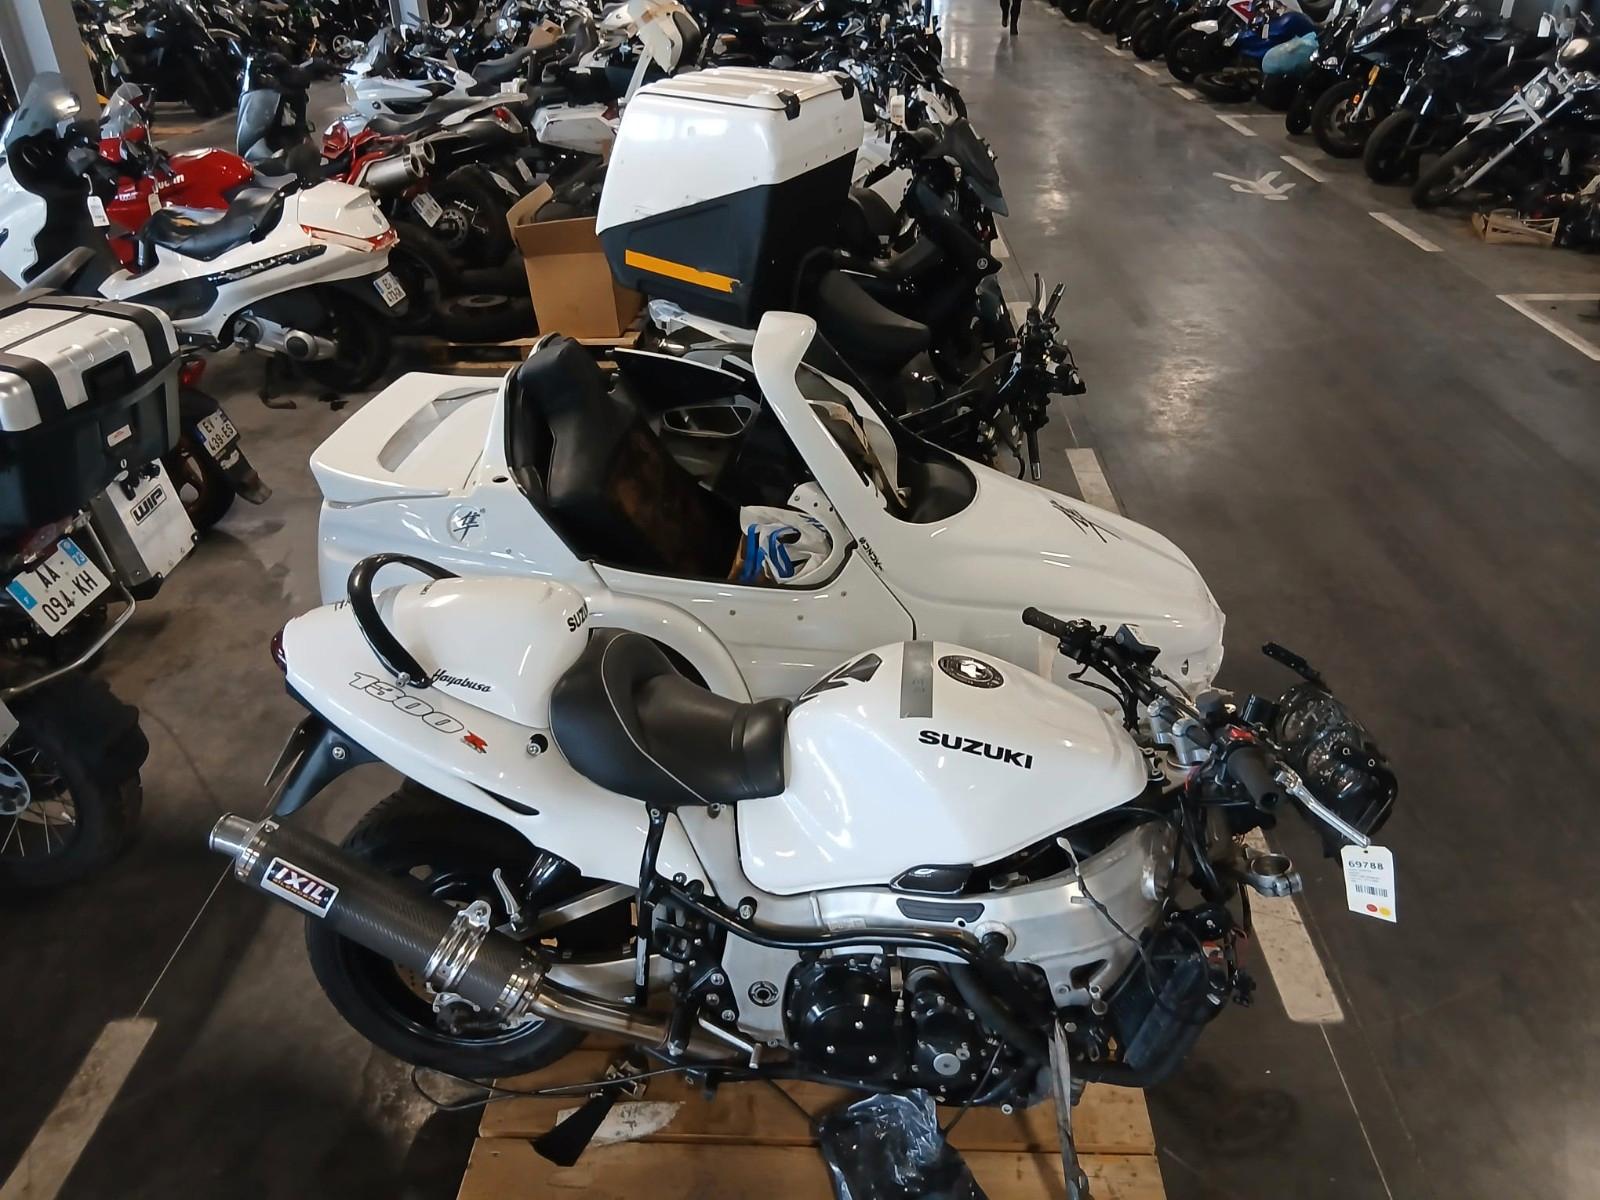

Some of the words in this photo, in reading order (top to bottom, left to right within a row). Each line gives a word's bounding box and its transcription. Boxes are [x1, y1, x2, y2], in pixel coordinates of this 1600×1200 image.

[431, 668, 492, 693] Hayabusa
[918, 730, 1033, 769] SUZUKI
[1348, 860, 1385, 870] 69788
[274, 867, 325, 901] IXIL
